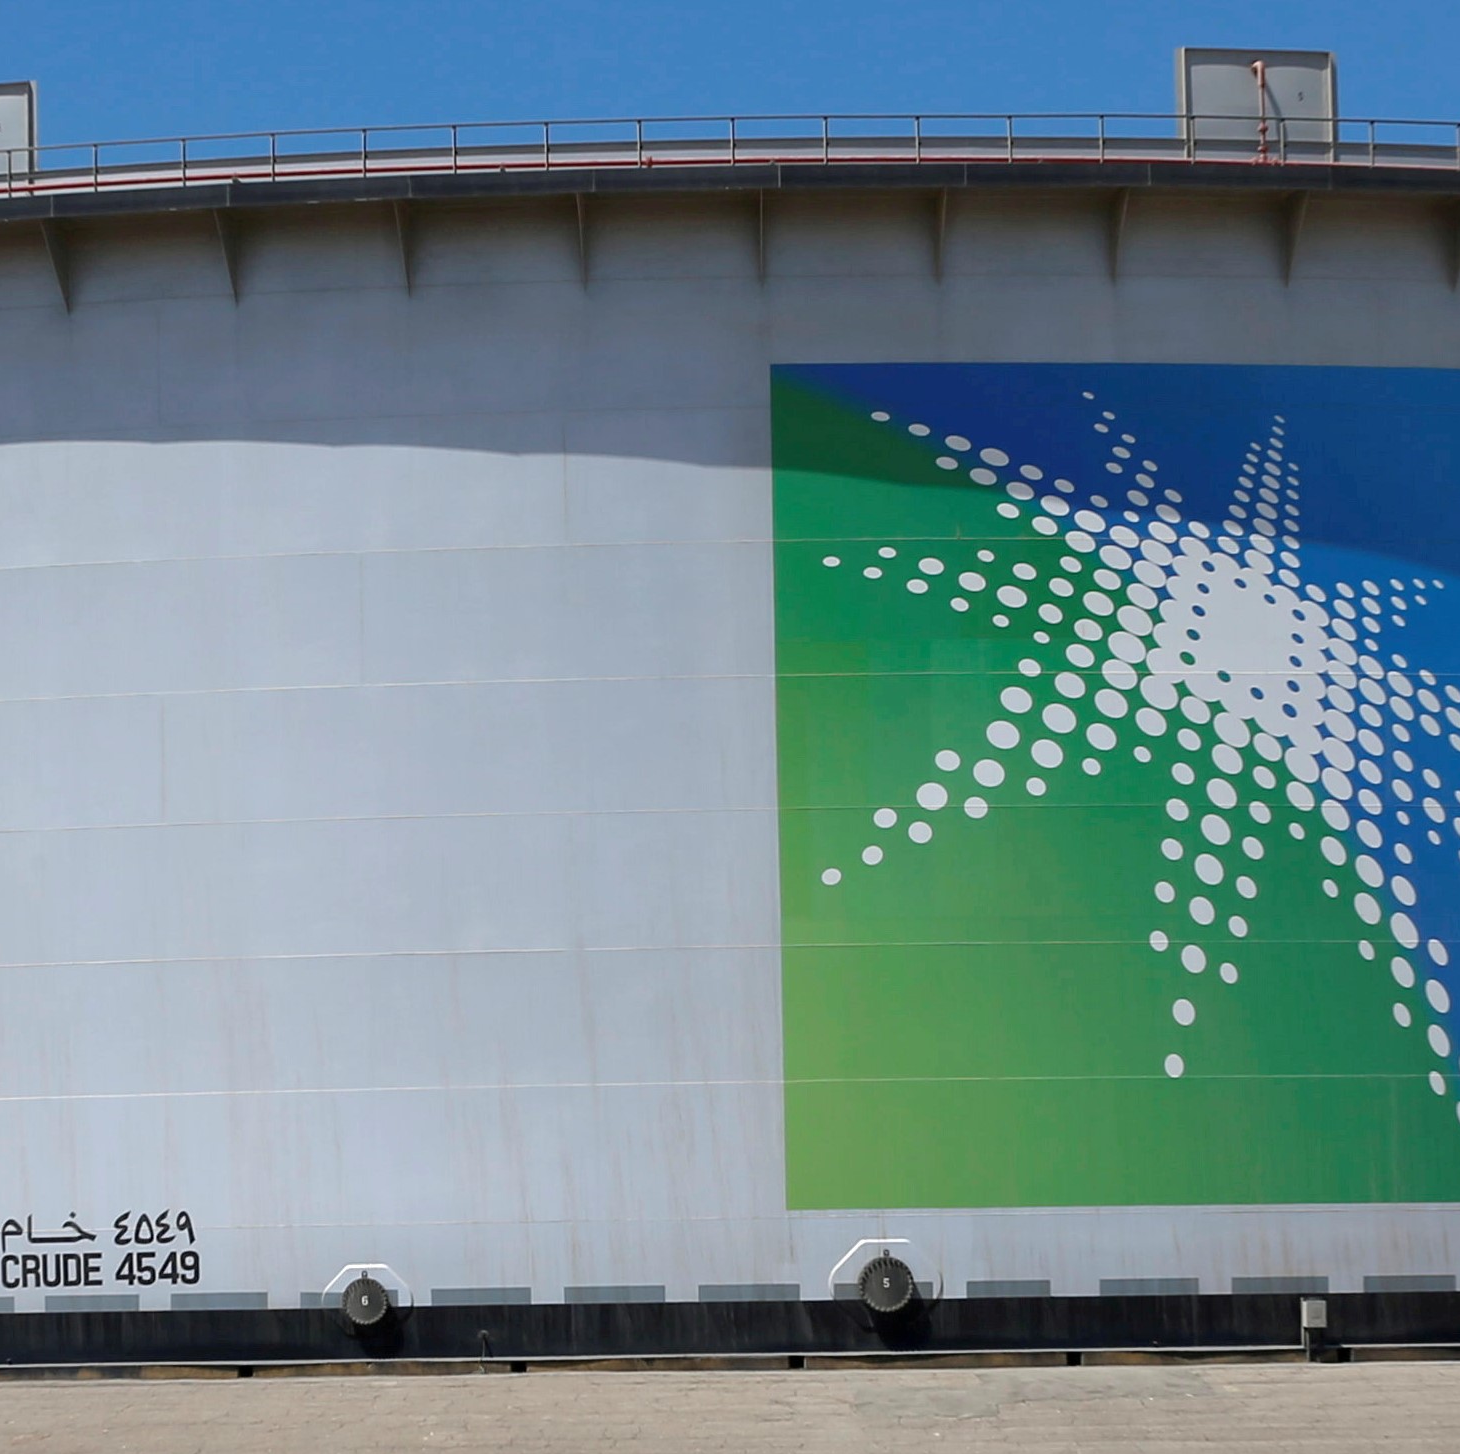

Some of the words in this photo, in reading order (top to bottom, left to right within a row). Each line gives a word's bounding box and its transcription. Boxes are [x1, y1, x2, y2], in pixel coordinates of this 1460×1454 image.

[1, 1211, 97, 1253] خام
[113, 1209, 196, 1246] ٤٥٤٩
[1, 1253, 104, 1289] CRUDE
[115, 1250, 201, 1286] 4549
[882, 1277, 891, 1289] 5
[361, 1295, 369, 1306] 6
